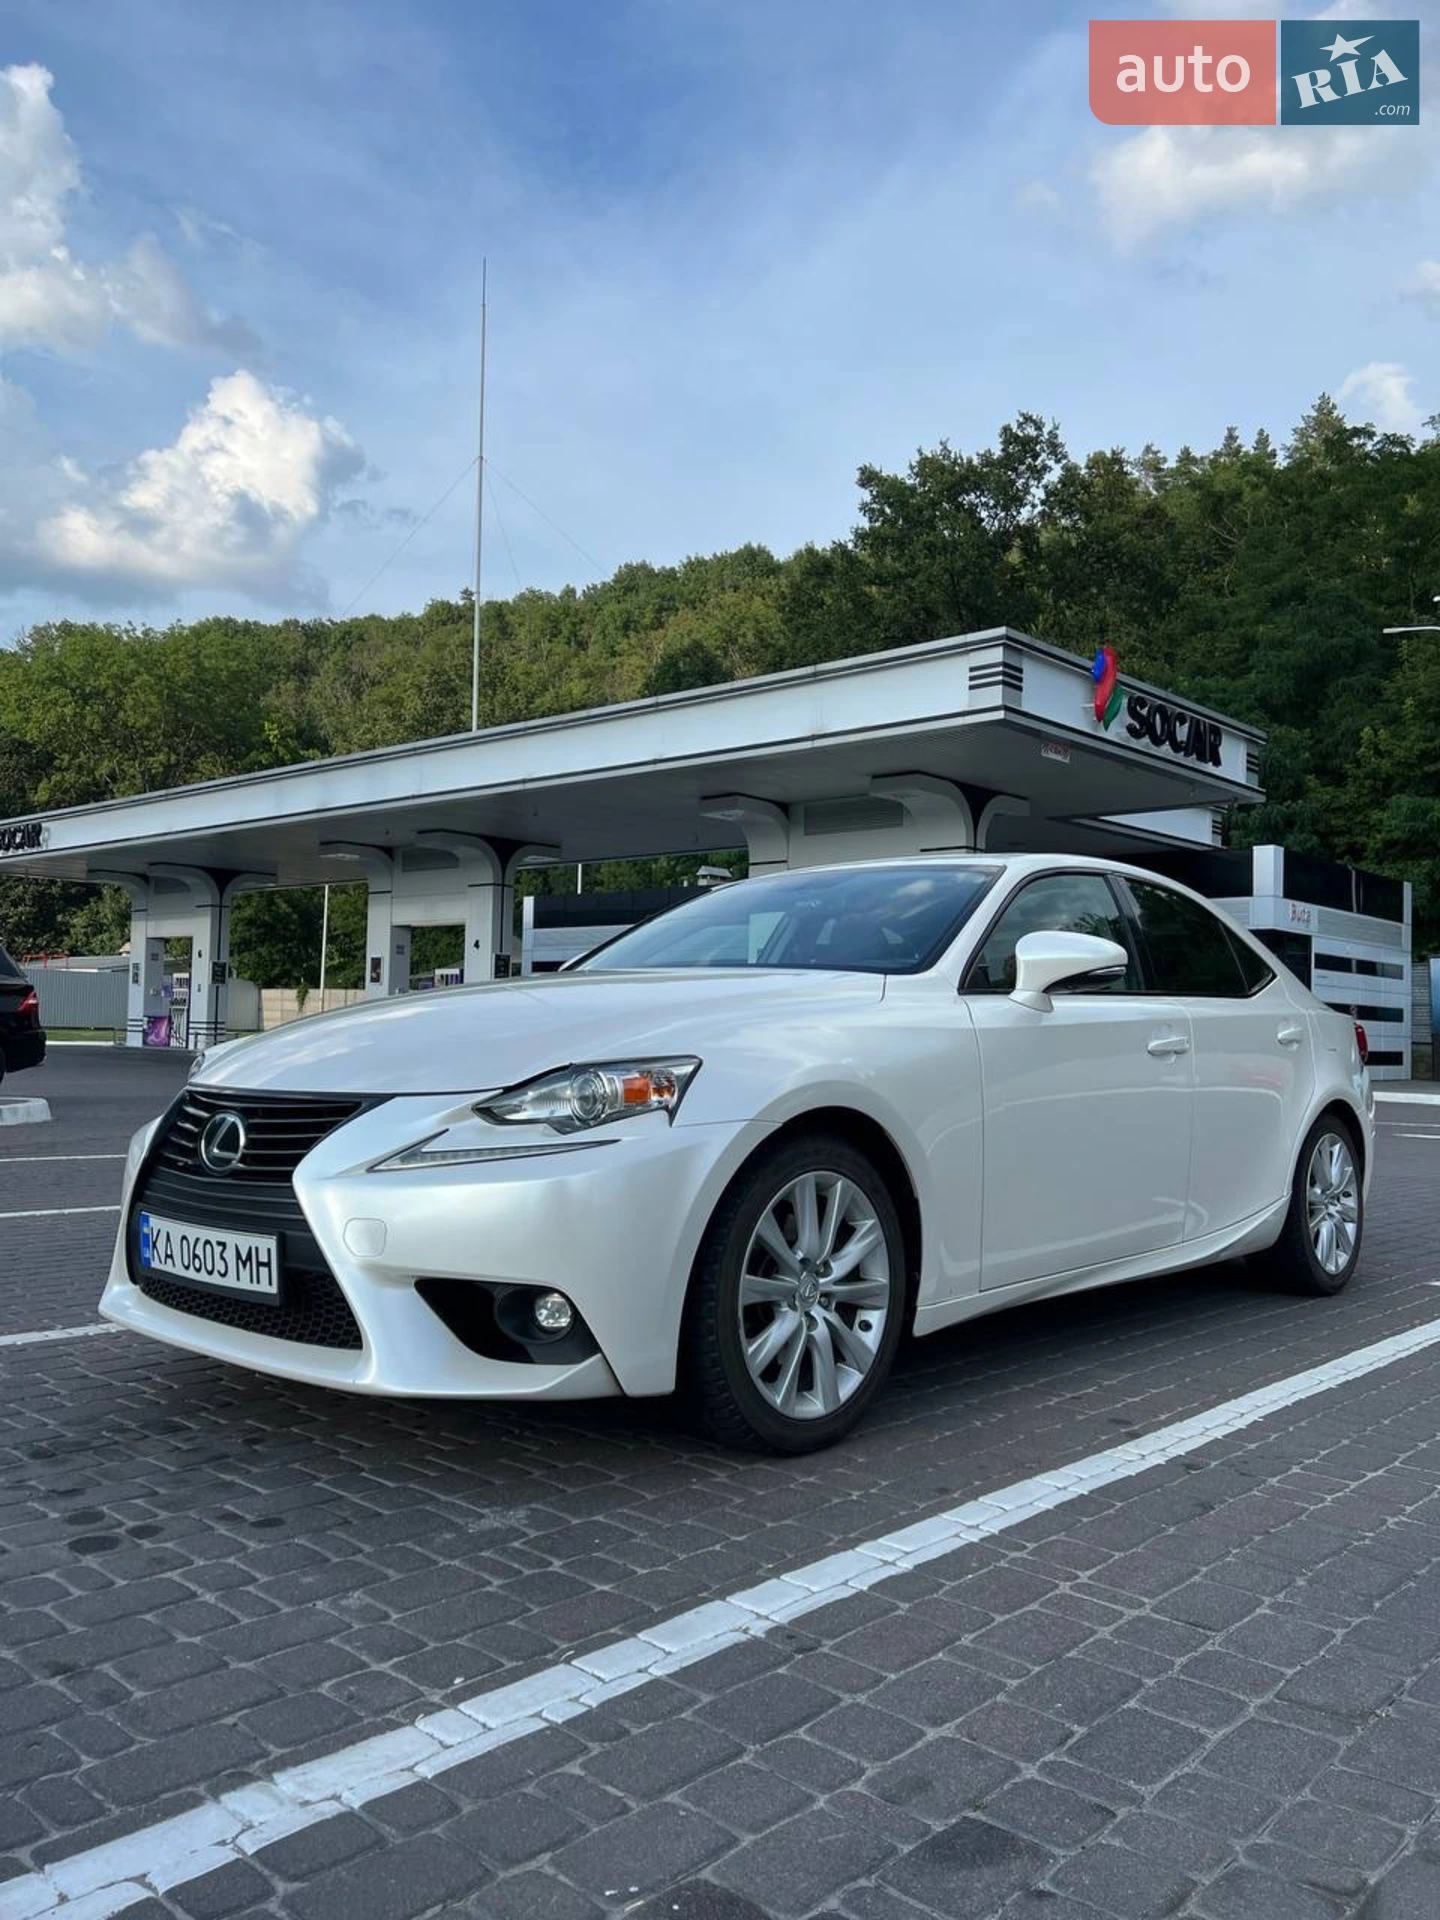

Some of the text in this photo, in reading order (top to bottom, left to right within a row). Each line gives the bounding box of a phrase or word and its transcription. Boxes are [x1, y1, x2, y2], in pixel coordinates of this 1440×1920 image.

[1126, 695, 1223, 768] SOCAR
[0, 822, 43, 851] OCAR
[150, 1226, 273, 1286] KA 0603 MH
